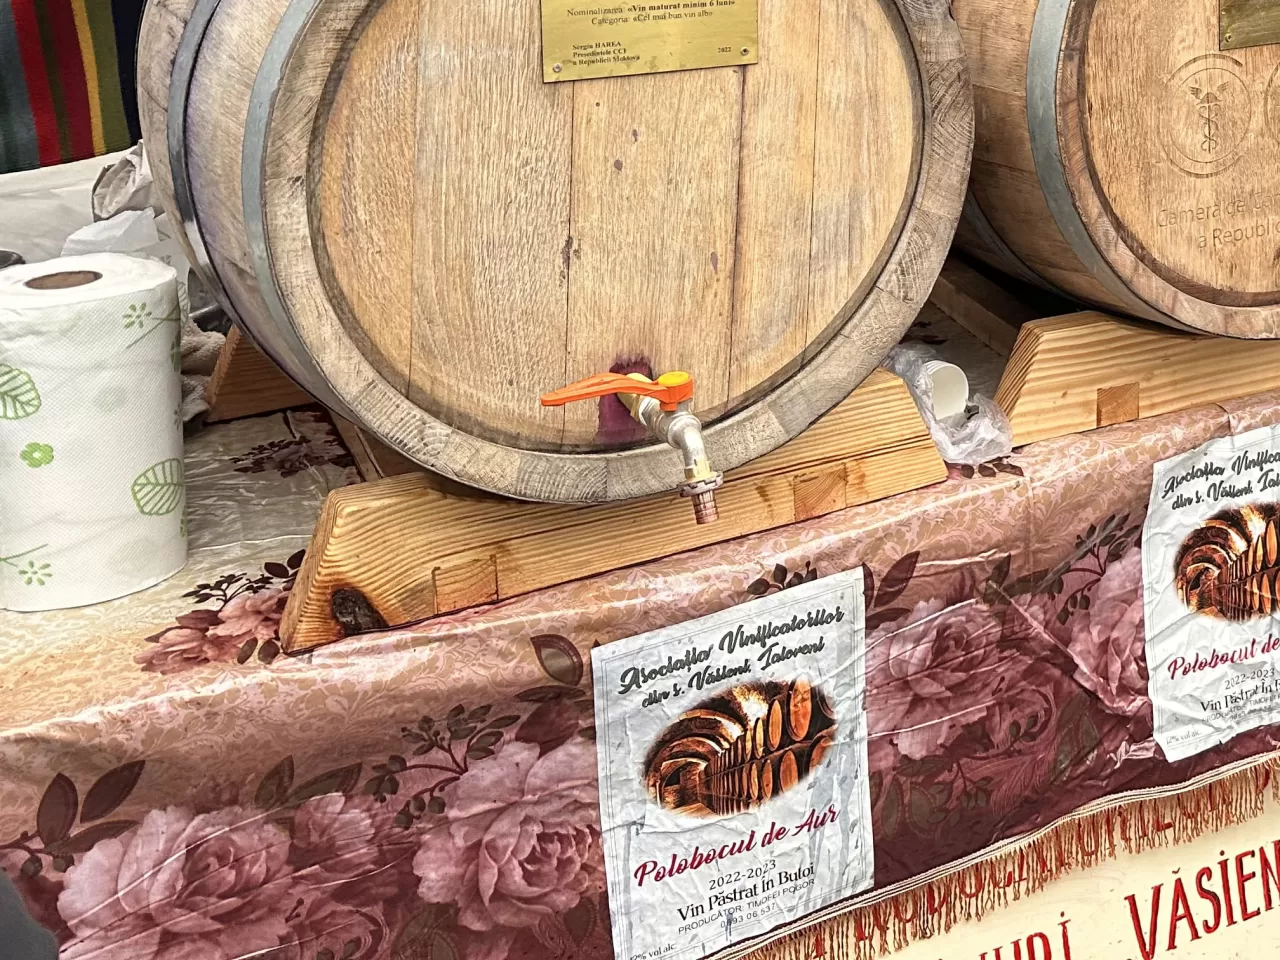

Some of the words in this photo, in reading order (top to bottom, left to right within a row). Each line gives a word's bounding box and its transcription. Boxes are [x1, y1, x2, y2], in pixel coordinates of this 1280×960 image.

[649, 2, 680, 11] maturat
[682, 0, 707, 9] minim
[709, 0, 714, 7] 6
[1171, 494, 1193, 510] din
[618, 644, 714, 694] Asociația
[719, 606, 845, 654] Vinificatorilor
[1167, 638, 1258, 680] Polobocul
[641, 689, 671, 708] din
[673, 683, 685, 697] s.
[757, 636, 825, 671] Ialoveni
[1224, 668, 1275, 690] 2022-2023
[1200, 699, 1222, 712] Vin
[634, 830, 757, 887] Polobocul
[761, 821, 790, 847] de
[791, 804, 840, 837] Aur
[709, 859, 776, 891] 2022-2023
[677, 903, 705, 921] Vin
[708, 883, 759, 911] Păstrat
[777, 862, 815, 886] Butoi
[747, 889, 781, 909] TIMOFEI
[782, 879, 815, 896] POGOR
[720, 916, 741, 929] 093
[746, 911, 758, 920] 06
[760, 902, 777, 916] 537
[648, 947, 661, 958] vol
